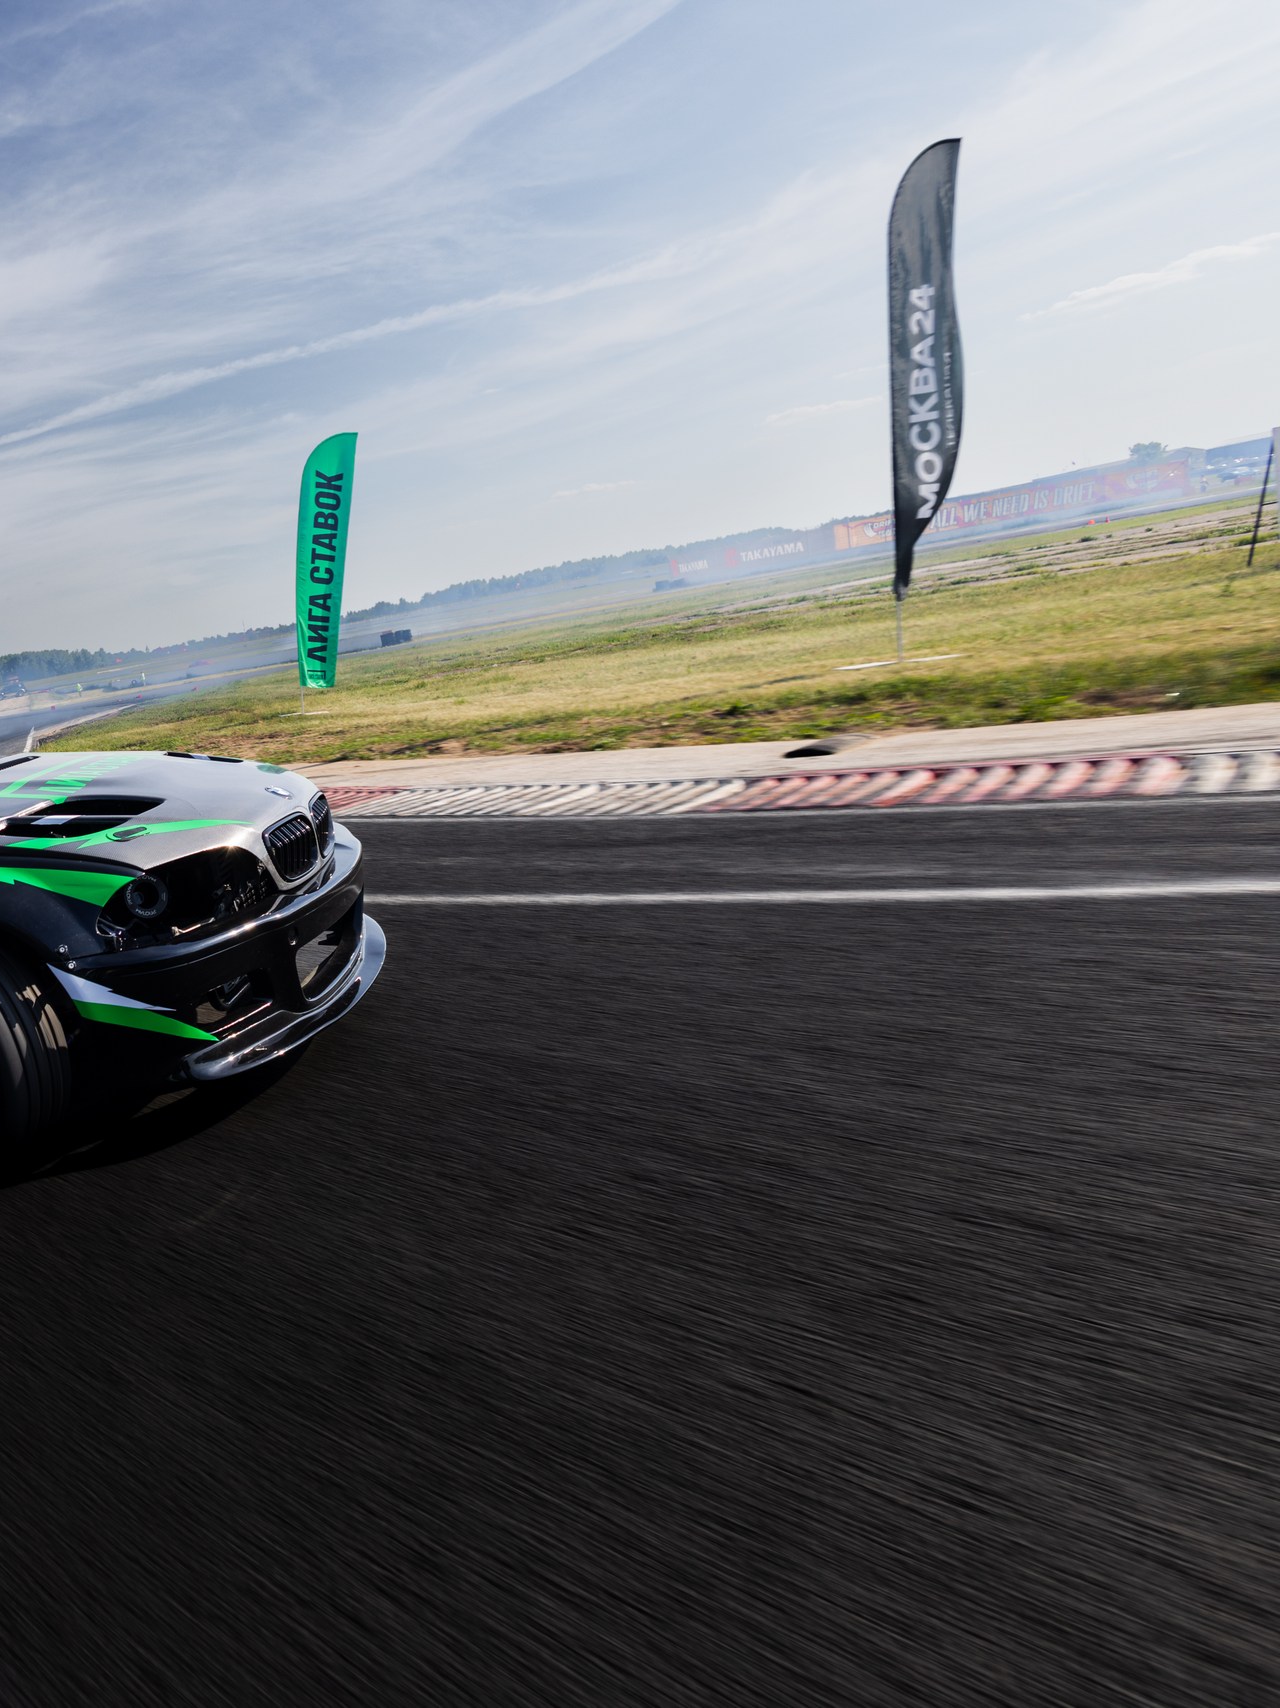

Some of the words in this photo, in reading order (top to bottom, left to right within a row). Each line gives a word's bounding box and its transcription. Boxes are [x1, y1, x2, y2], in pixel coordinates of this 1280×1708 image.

[309, 470, 344, 585] СТАВОК
[930, 507, 957, 529] ALL
[963, 501, 988, 523] WE
[992, 494, 1029, 518] NEED
[1034, 489, 1049, 510] IS
[1053, 481, 1096, 507] DRIFT
[740, 541, 805, 562] TAKAYAMA
[307, 593, 332, 663] ЛИГА
